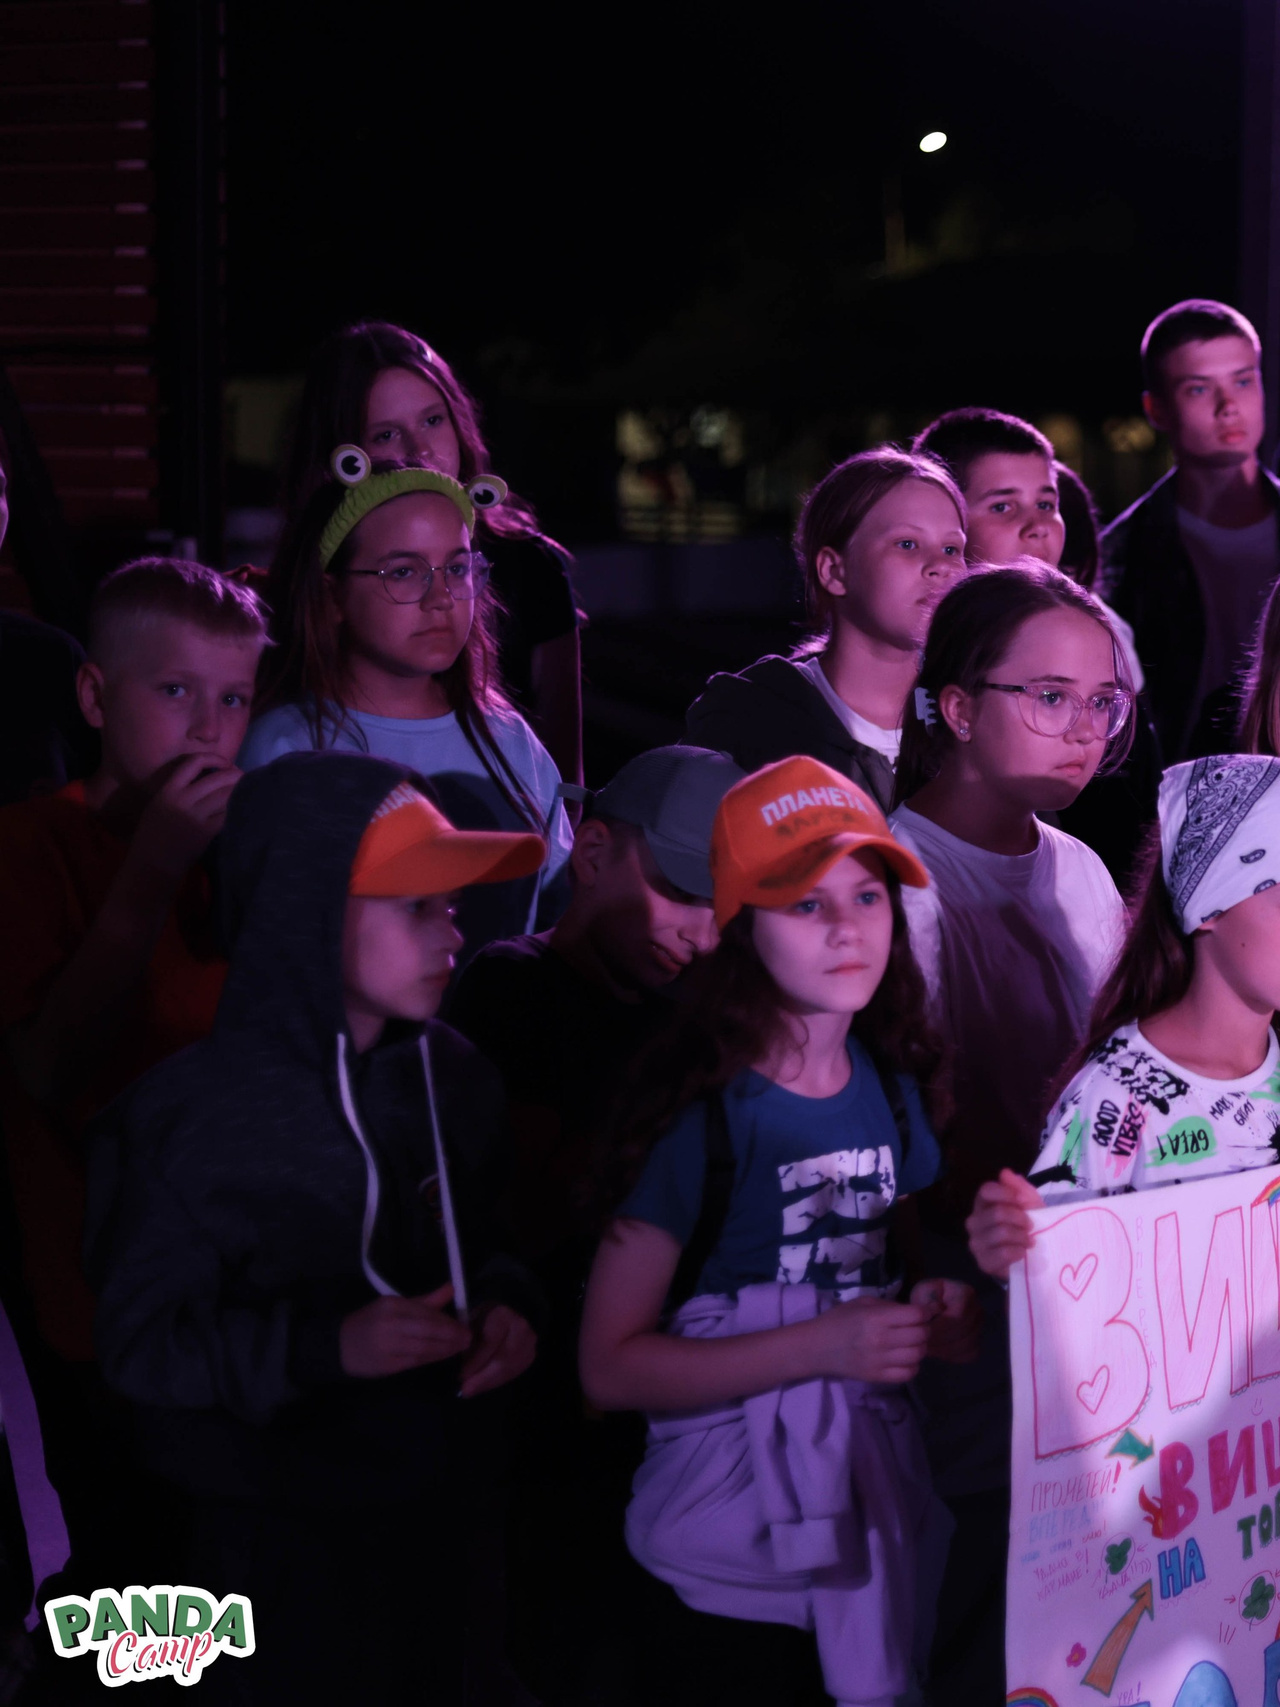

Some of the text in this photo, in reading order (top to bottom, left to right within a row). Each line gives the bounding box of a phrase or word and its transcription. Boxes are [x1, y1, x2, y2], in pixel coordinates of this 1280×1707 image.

[1092, 1098, 1121, 1148] GOOD
[1111, 1102, 1145, 1157] VIBES
[1157, 1538, 1207, 1600] НА
